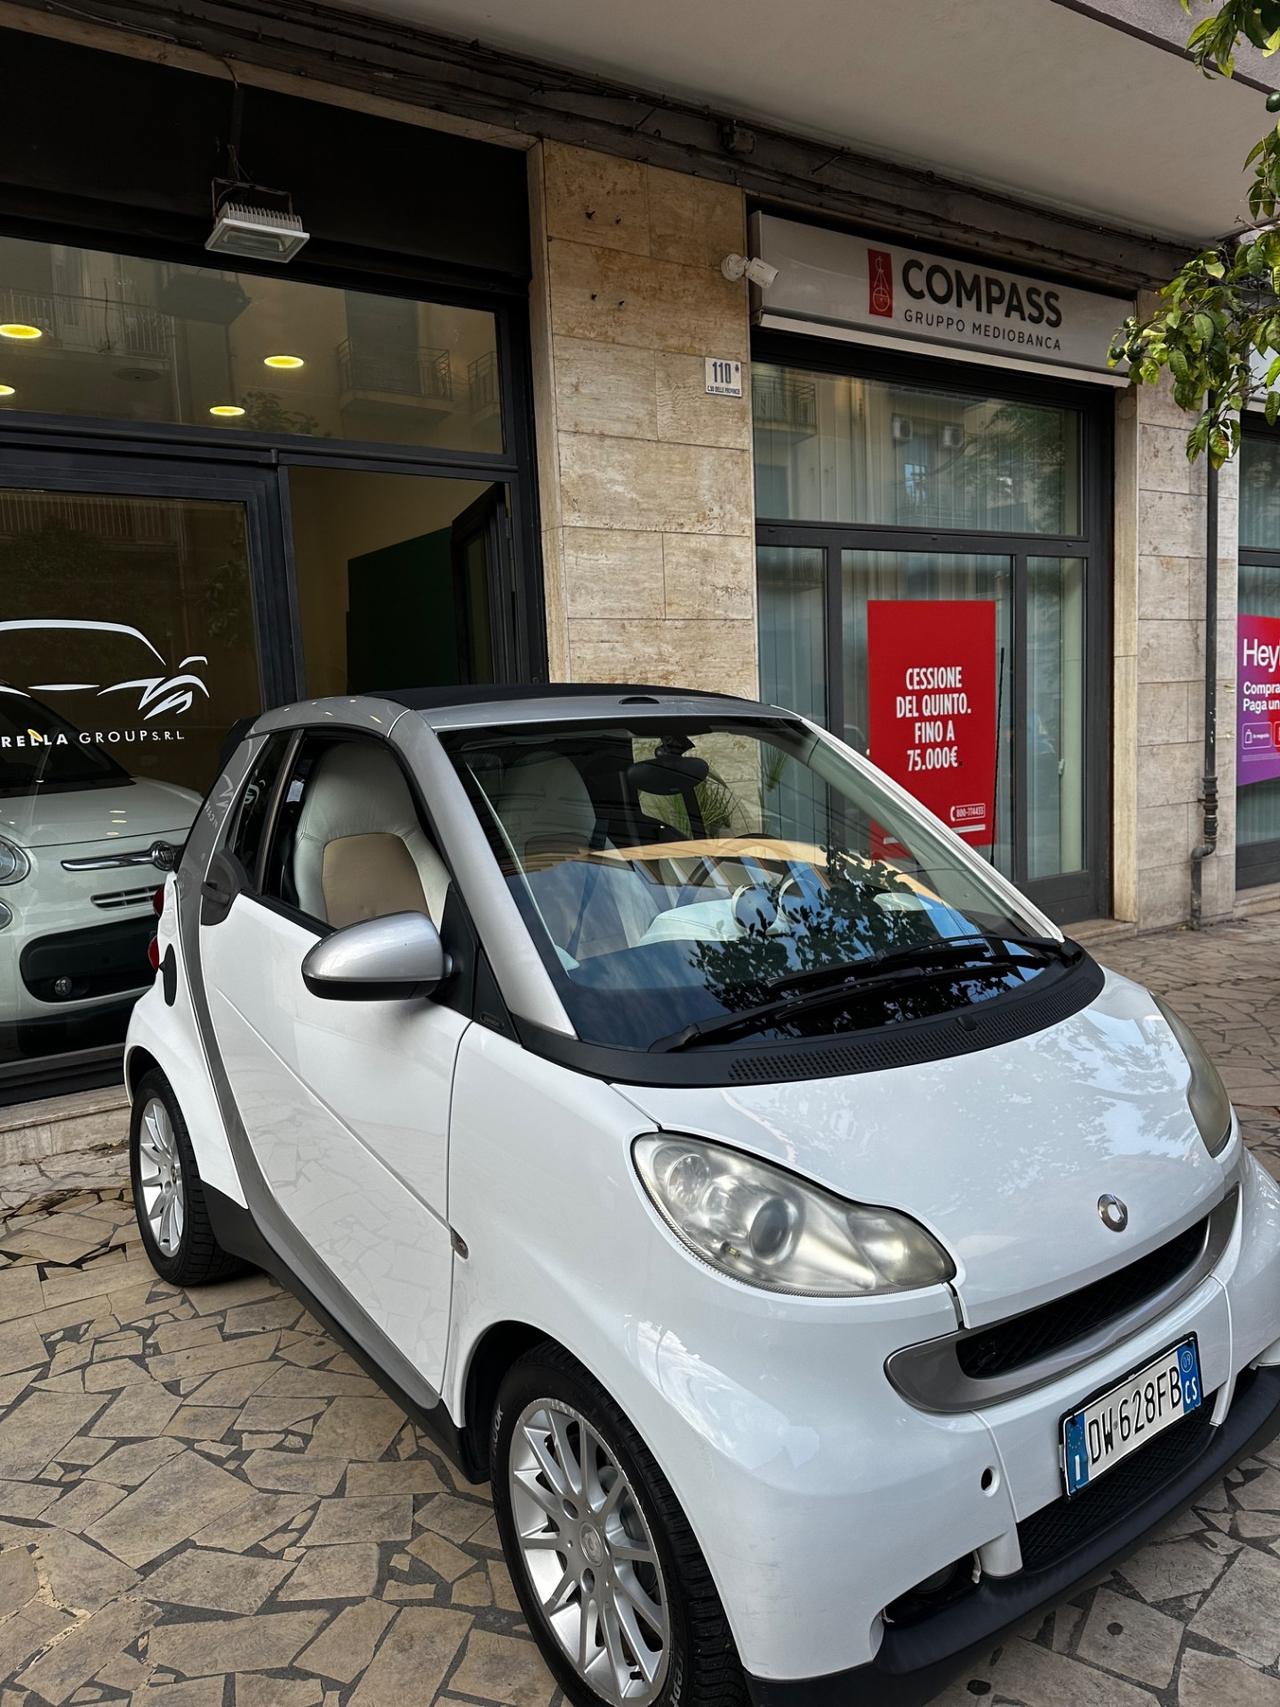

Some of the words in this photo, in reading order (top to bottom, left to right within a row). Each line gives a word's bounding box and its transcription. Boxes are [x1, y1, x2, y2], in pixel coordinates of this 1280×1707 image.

[902, 258, 1063, 328] COMPASS
[904, 308, 966, 333] GRUPPO
[972, 322, 1062, 351] MEDIOBANCA
[712, 361, 732, 384] 110
[1243, 638, 1280, 673] Hey
[906, 666, 962, 690] CESSIONE
[896, 696, 919, 718] DEL
[922, 692, 972, 716] QUINTO.
[1243, 698, 1268, 714] Paga
[79, 730, 148, 744] GROUP
[914, 720, 943, 744] FINO
[946, 720, 955, 742] A
[907, 746, 958, 771] 75.000€
[1185, 1376, 1197, 1404] CS
